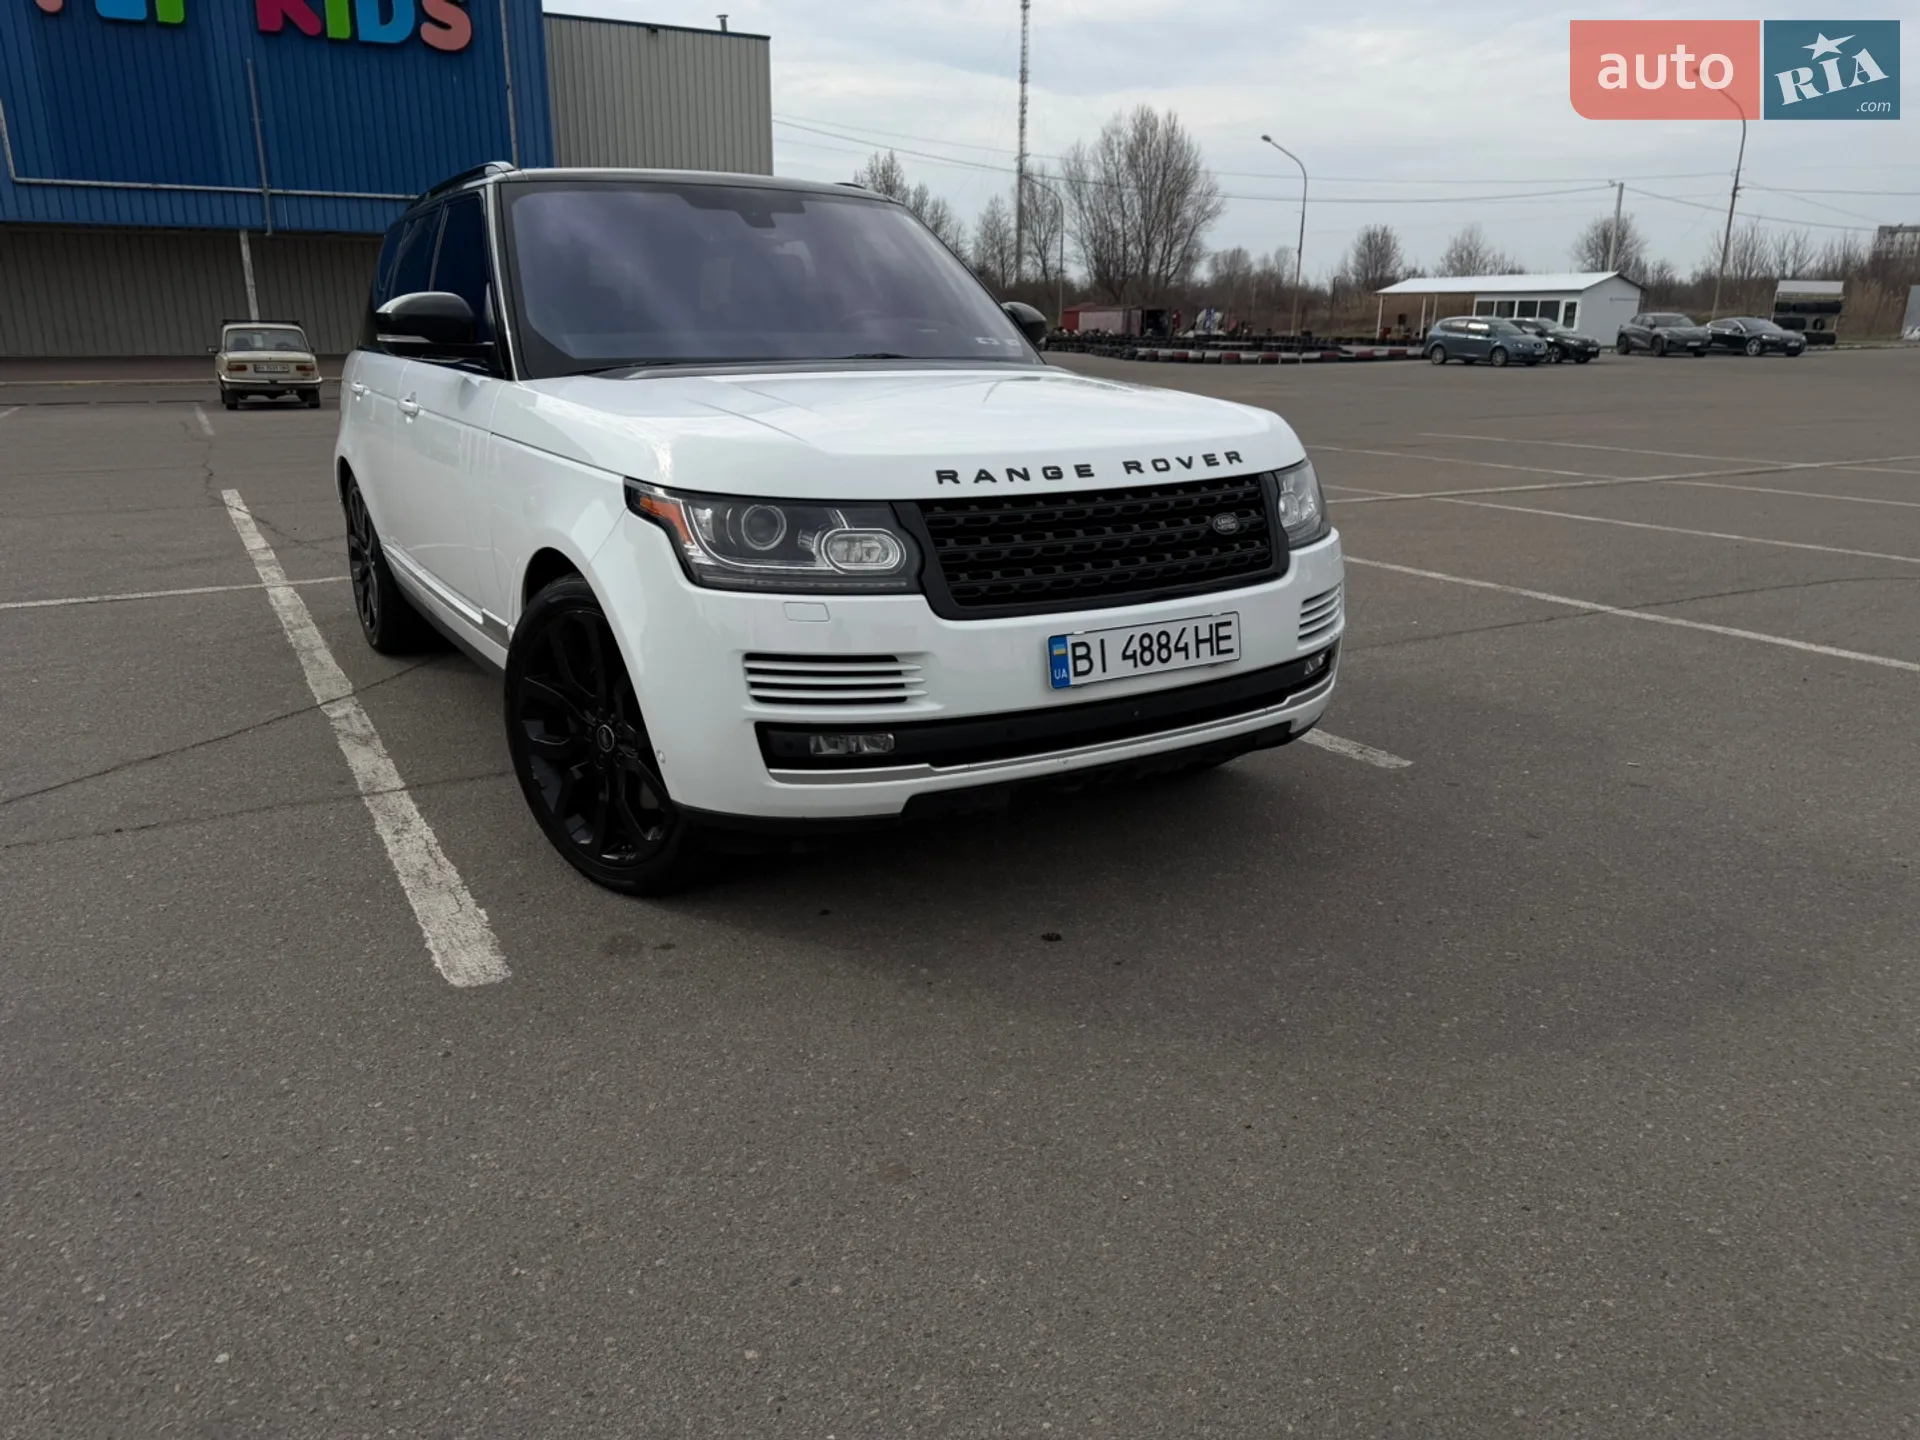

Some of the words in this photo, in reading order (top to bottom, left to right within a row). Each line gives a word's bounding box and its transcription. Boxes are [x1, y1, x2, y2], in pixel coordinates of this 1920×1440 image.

[936, 464, 1095, 485] RANGE
[1122, 451, 1244, 475] ROVER
[1054, 668, 1068, 680] UA
[1071, 638, 1107, 677] BI
